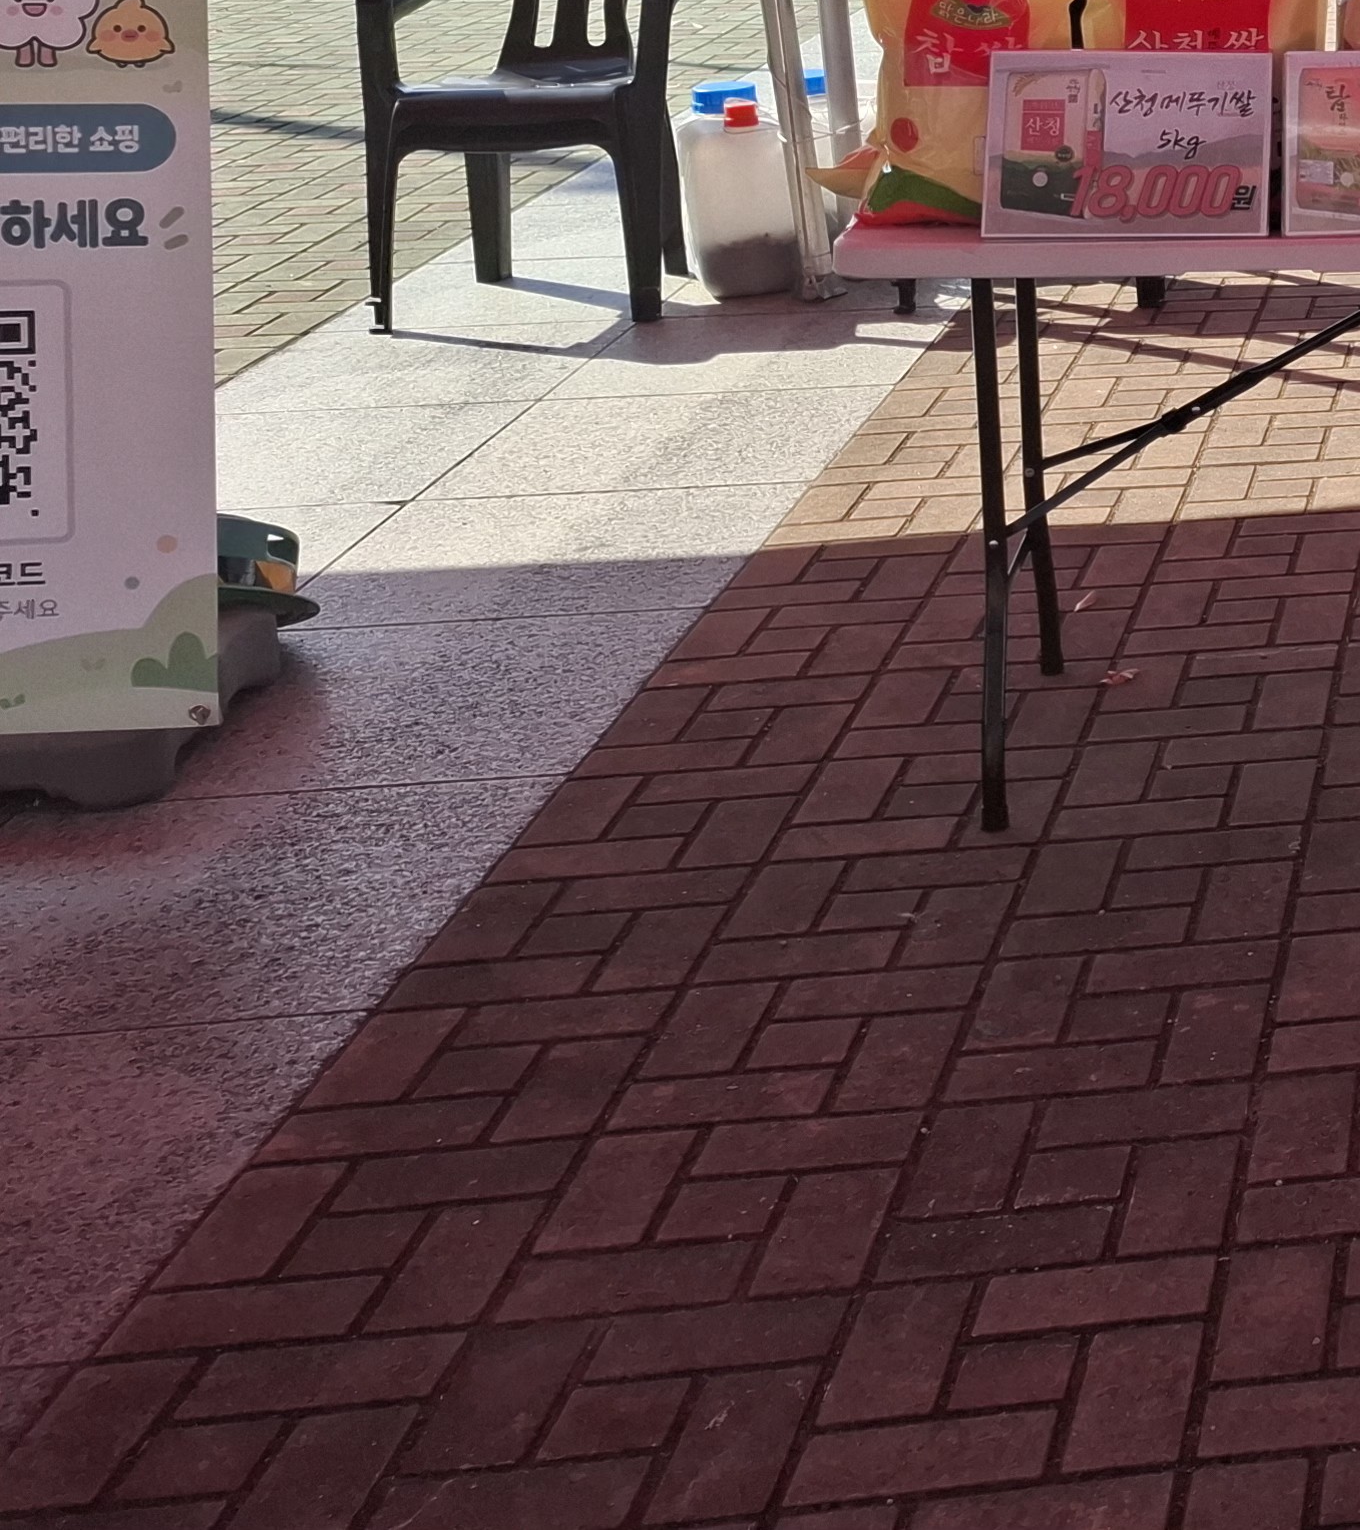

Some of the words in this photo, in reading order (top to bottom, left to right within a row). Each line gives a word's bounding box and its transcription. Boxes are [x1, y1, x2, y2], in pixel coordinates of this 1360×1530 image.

[1108, 88, 1257, 119] 산청메뚜기쌀
[0, 123, 81, 153] 편리한
[88, 123, 140, 153] 쇼핑
[1156, 128, 1207, 161] 5kg
